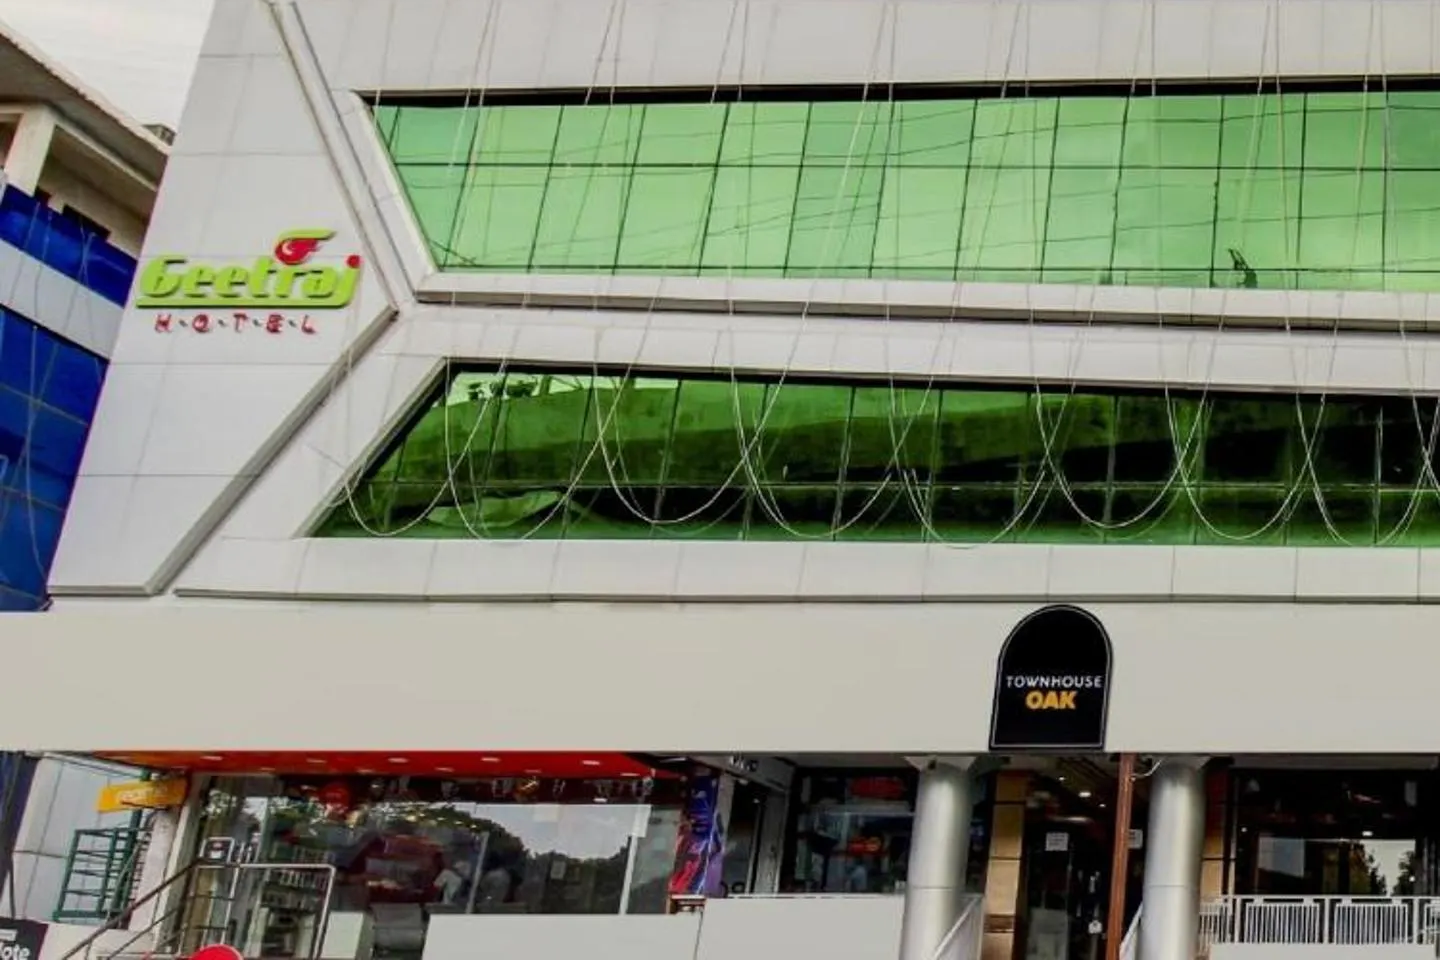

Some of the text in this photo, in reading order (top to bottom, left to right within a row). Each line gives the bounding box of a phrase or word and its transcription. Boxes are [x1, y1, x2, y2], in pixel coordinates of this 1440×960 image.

[137, 253, 362, 309] Geetraj
[1006, 675, 1103, 688] TOWNHOUSE
[1025, 690, 1077, 710] OAK
